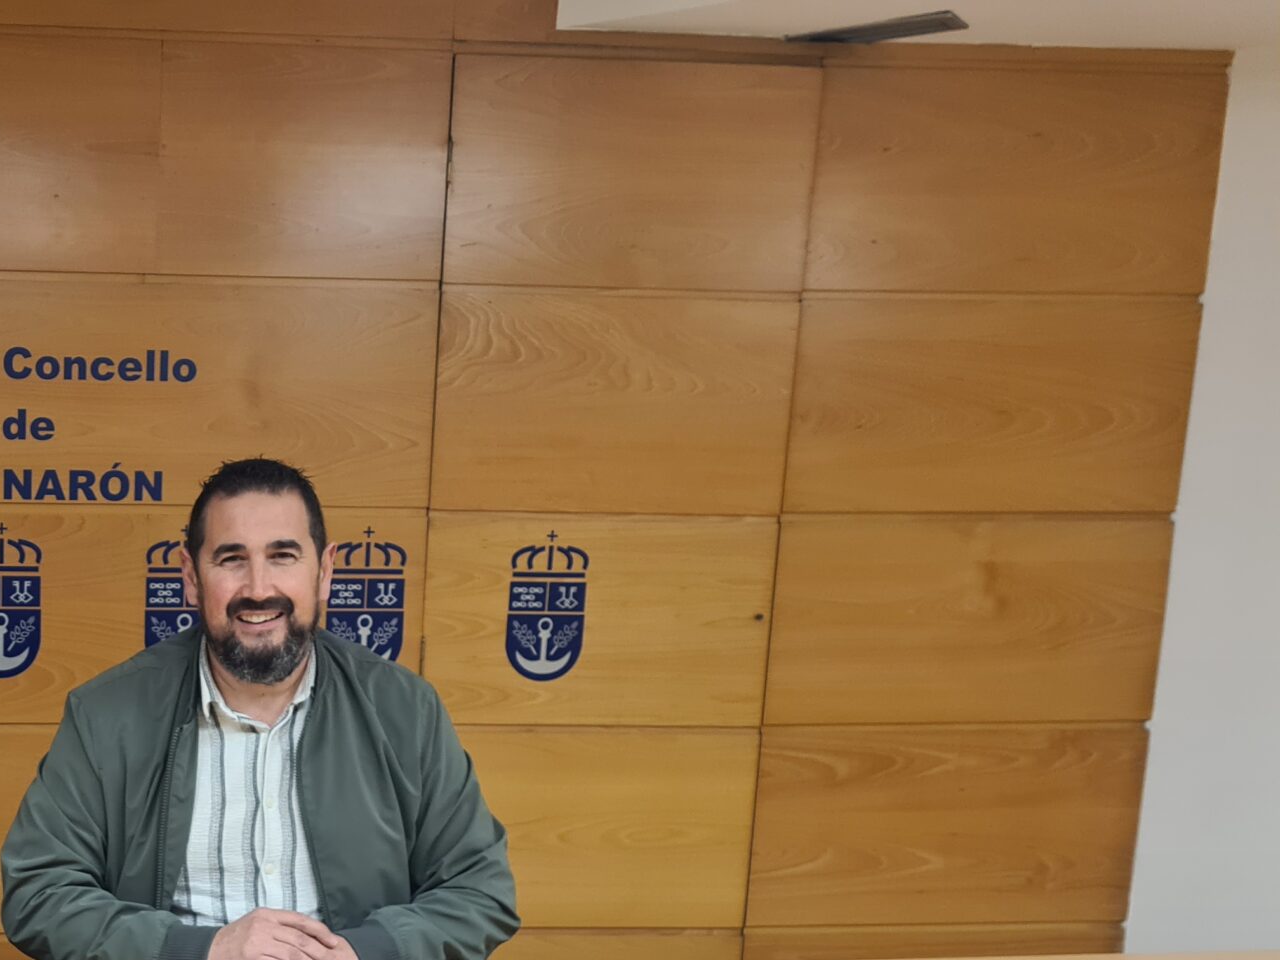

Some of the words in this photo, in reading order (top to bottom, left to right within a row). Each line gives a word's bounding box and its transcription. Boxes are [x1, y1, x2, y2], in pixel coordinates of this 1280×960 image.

[2, 346, 197, 382] Concello
[2, 408, 55, 441] de
[2, 462, 163, 502] NARÓN
